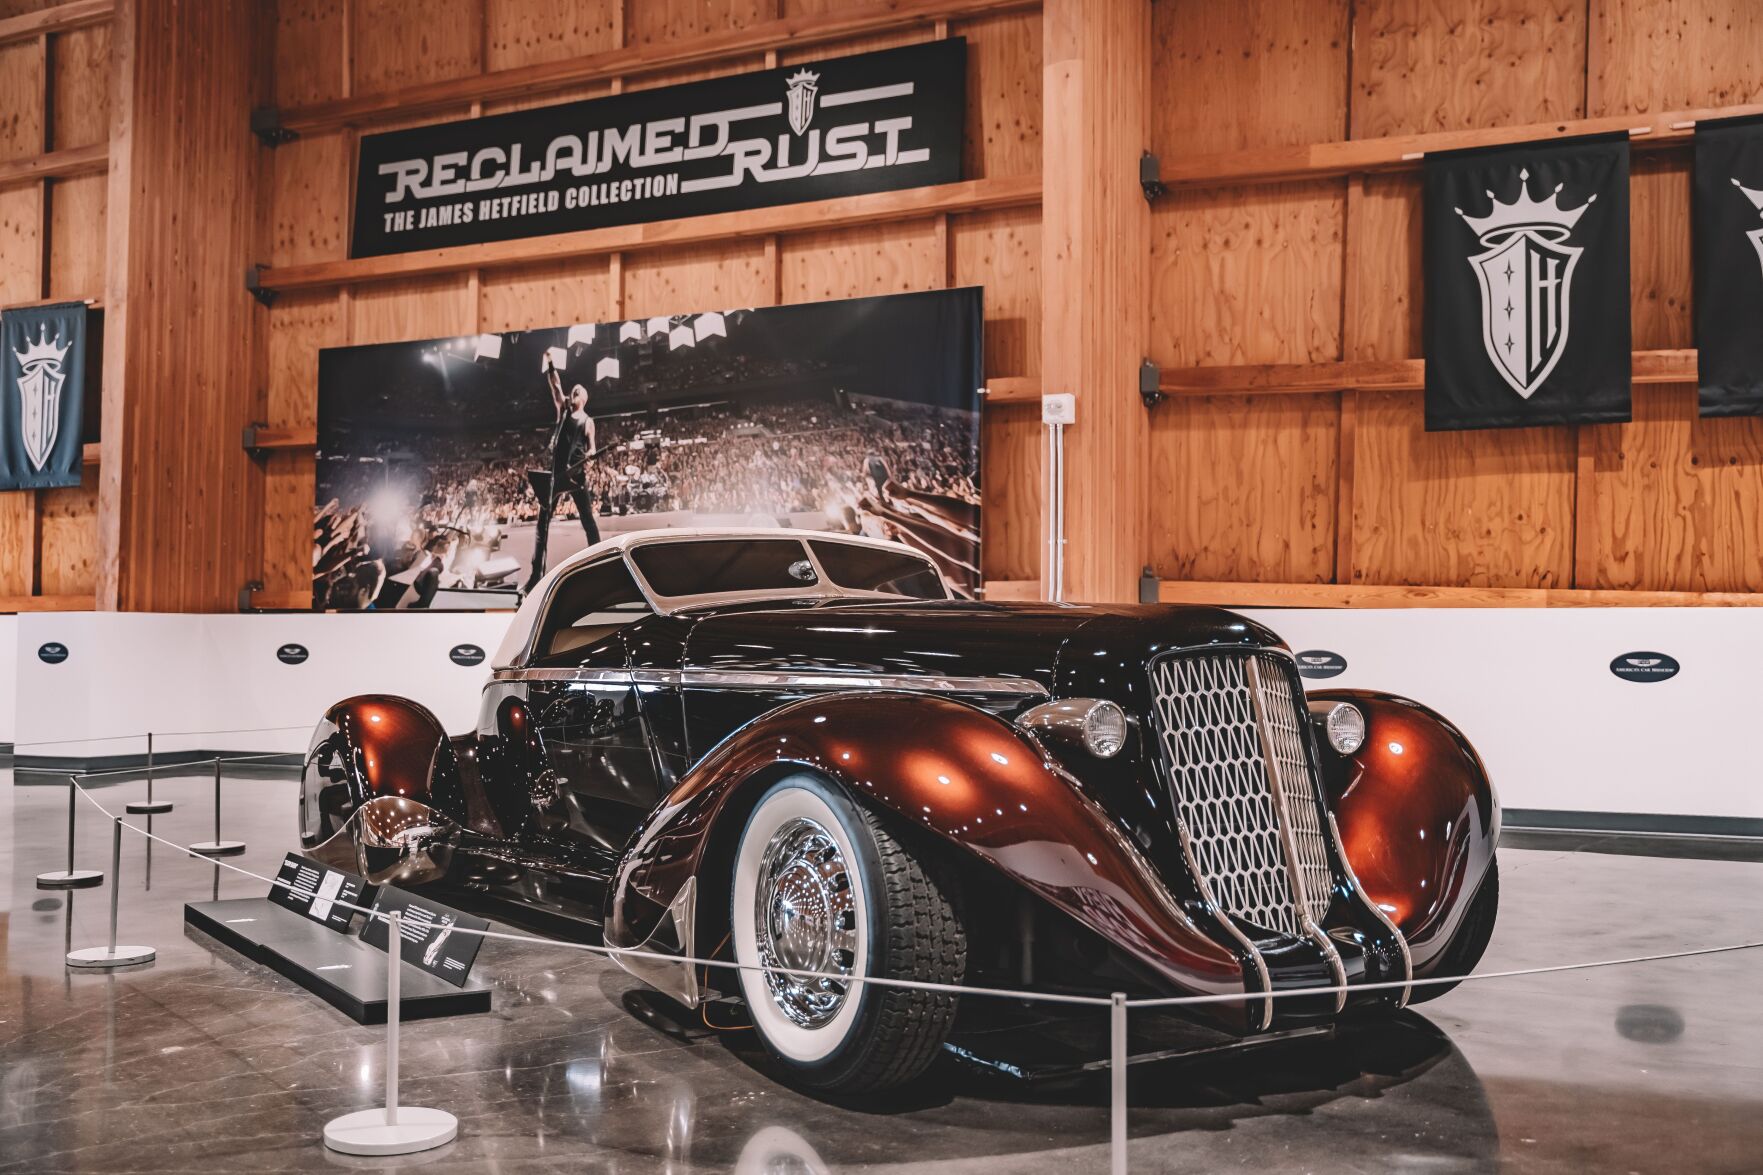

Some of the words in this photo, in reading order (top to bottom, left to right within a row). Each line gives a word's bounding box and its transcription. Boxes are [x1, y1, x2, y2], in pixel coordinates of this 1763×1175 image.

[378, 108, 750, 203] RECLAIMED
[696, 116, 930, 191] RUST
[384, 211, 414, 233] THE
[418, 202, 474, 229] JAMES
[479, 190, 560, 221] HETFIELD
[565, 173, 679, 209] COLLECTION
